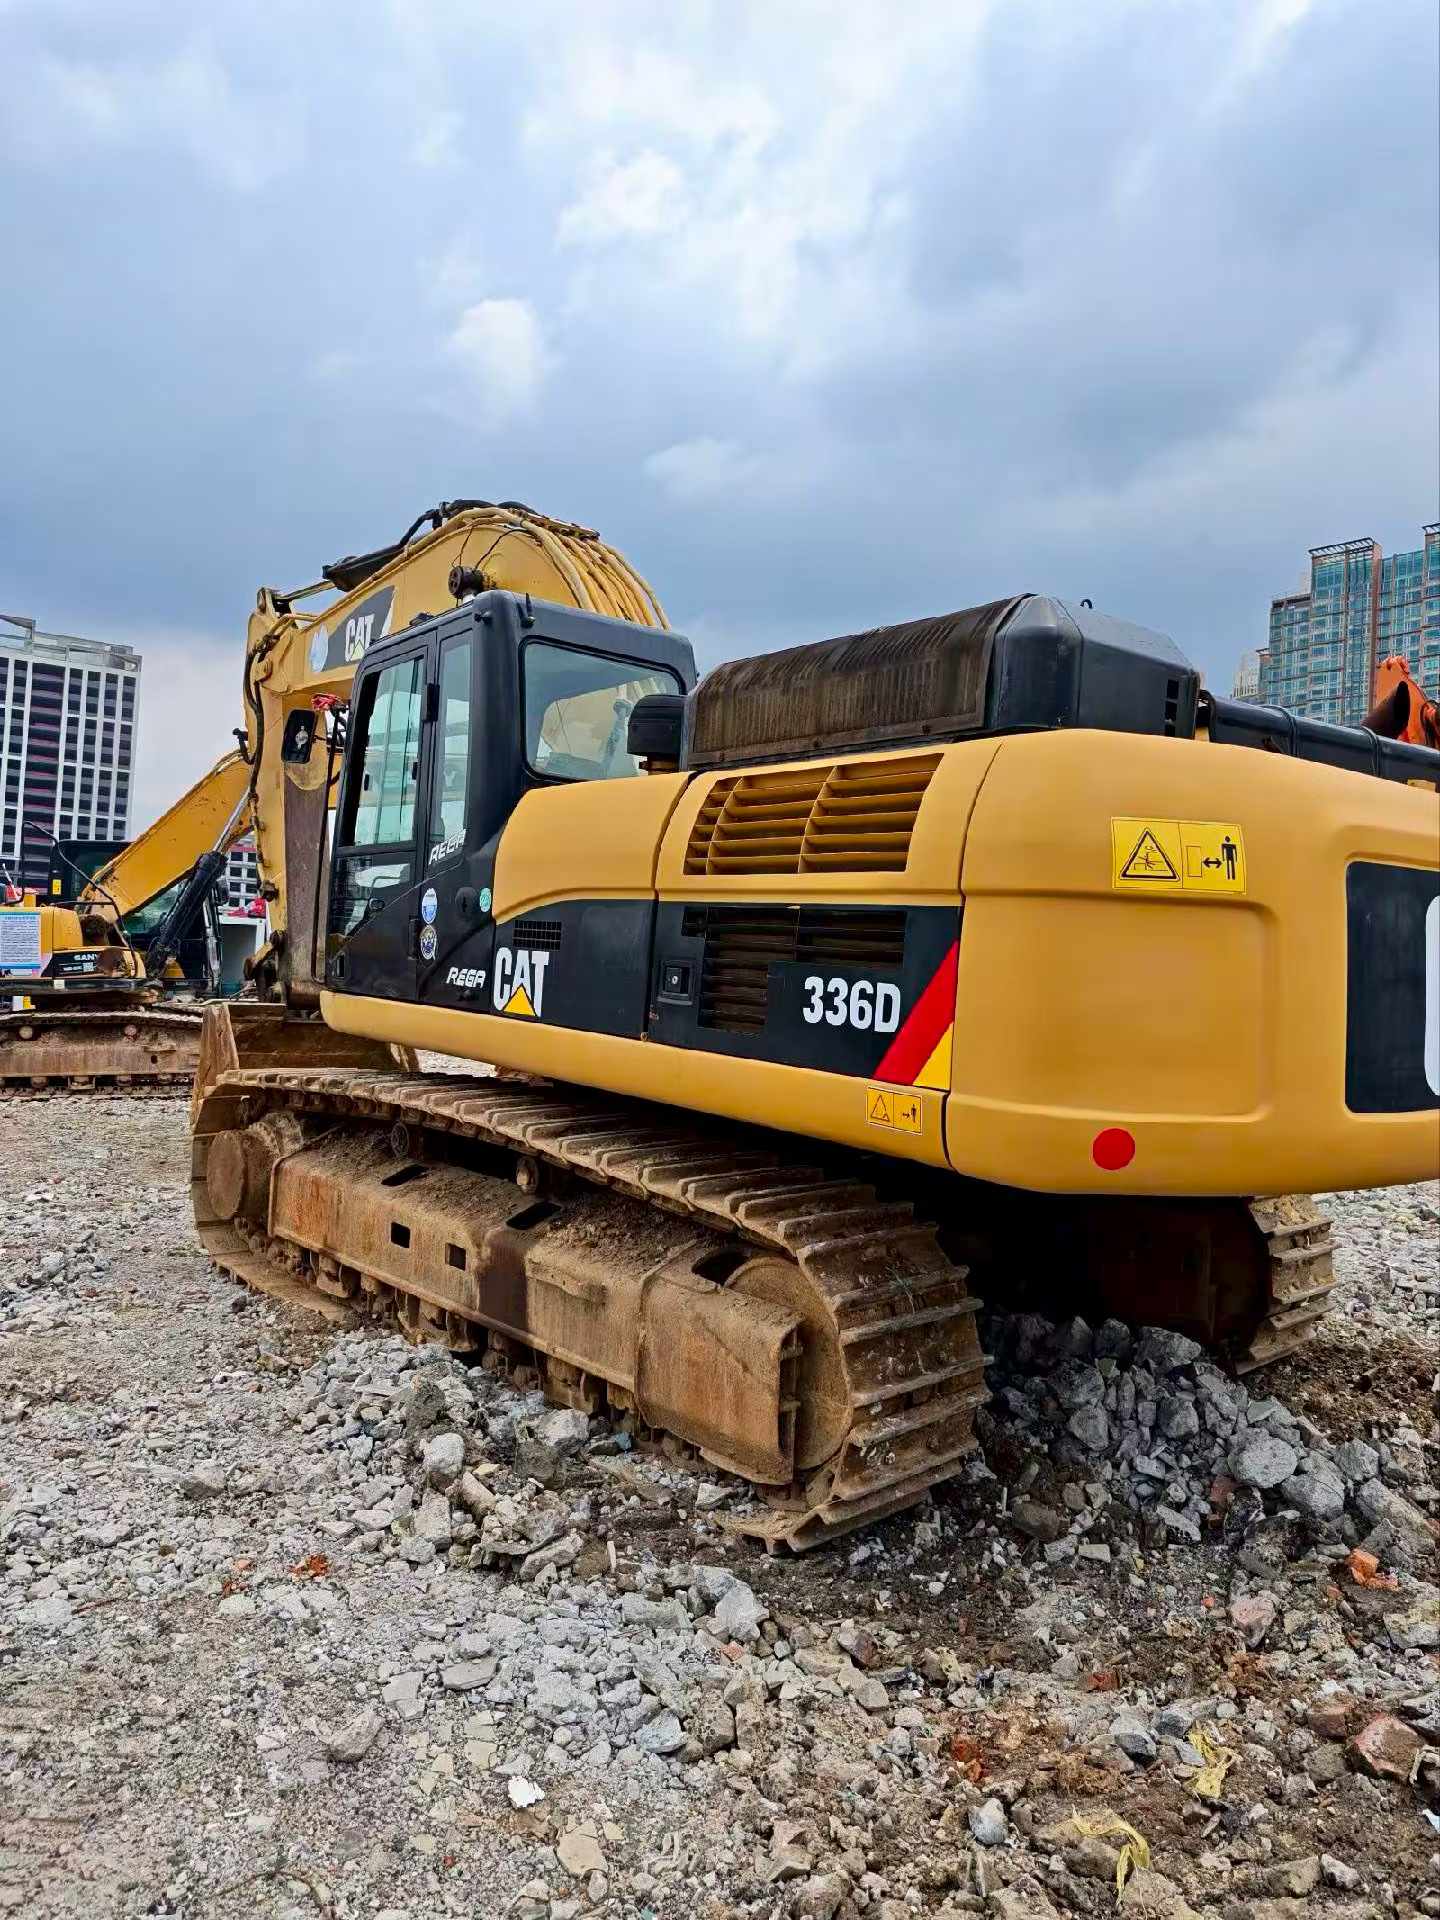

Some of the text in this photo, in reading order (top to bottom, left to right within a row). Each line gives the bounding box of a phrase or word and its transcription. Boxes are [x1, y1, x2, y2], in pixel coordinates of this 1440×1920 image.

[345, 613, 375, 662] CAT
[74, 953, 98, 961] SAN
[446, 966, 487, 989] REGA
[494, 947, 550, 1017] CAT
[803, 976, 901, 1033] 336D
